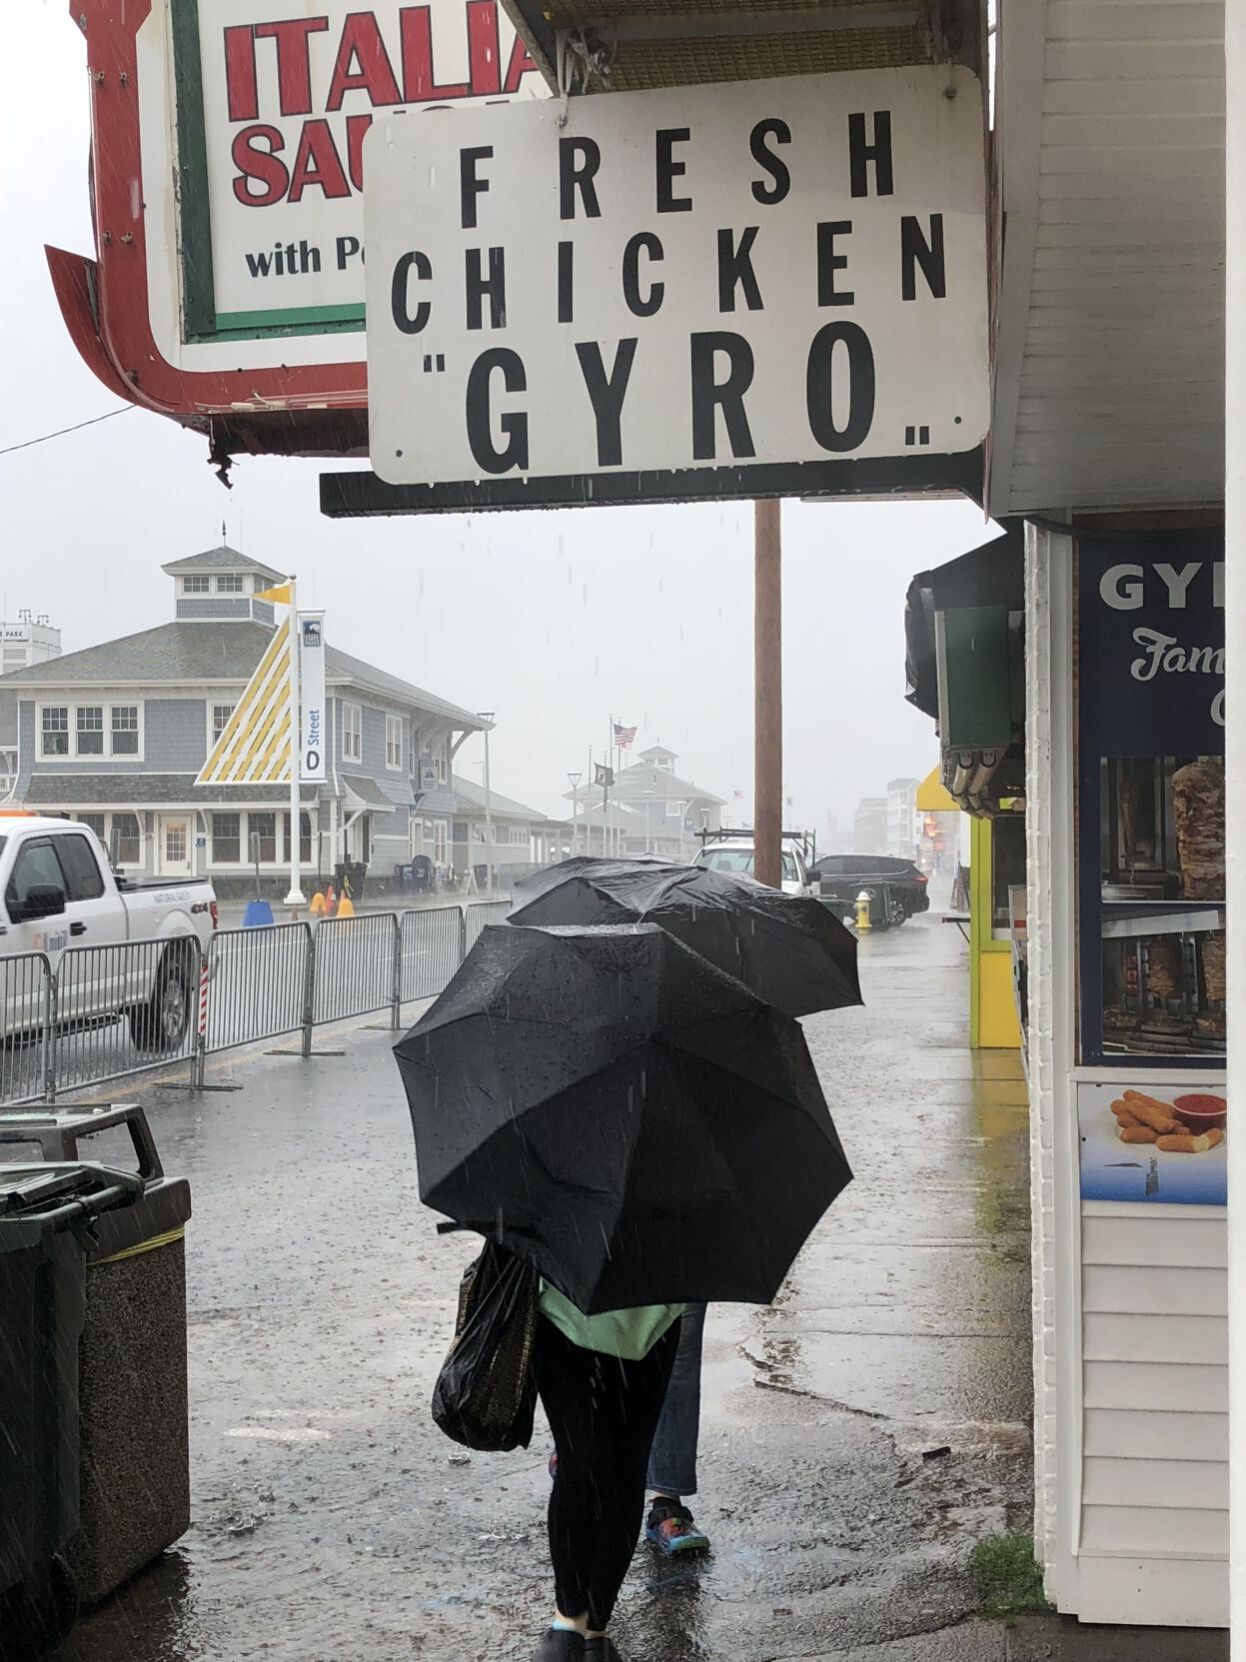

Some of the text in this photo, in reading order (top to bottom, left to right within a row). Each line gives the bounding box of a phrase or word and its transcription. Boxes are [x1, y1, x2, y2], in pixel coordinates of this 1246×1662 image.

[460, 110, 894, 229] FRESH
[245, 236, 365, 278] with P
[391, 213, 946, 334] CHICKEN
[306, 709, 320, 771] D Street
